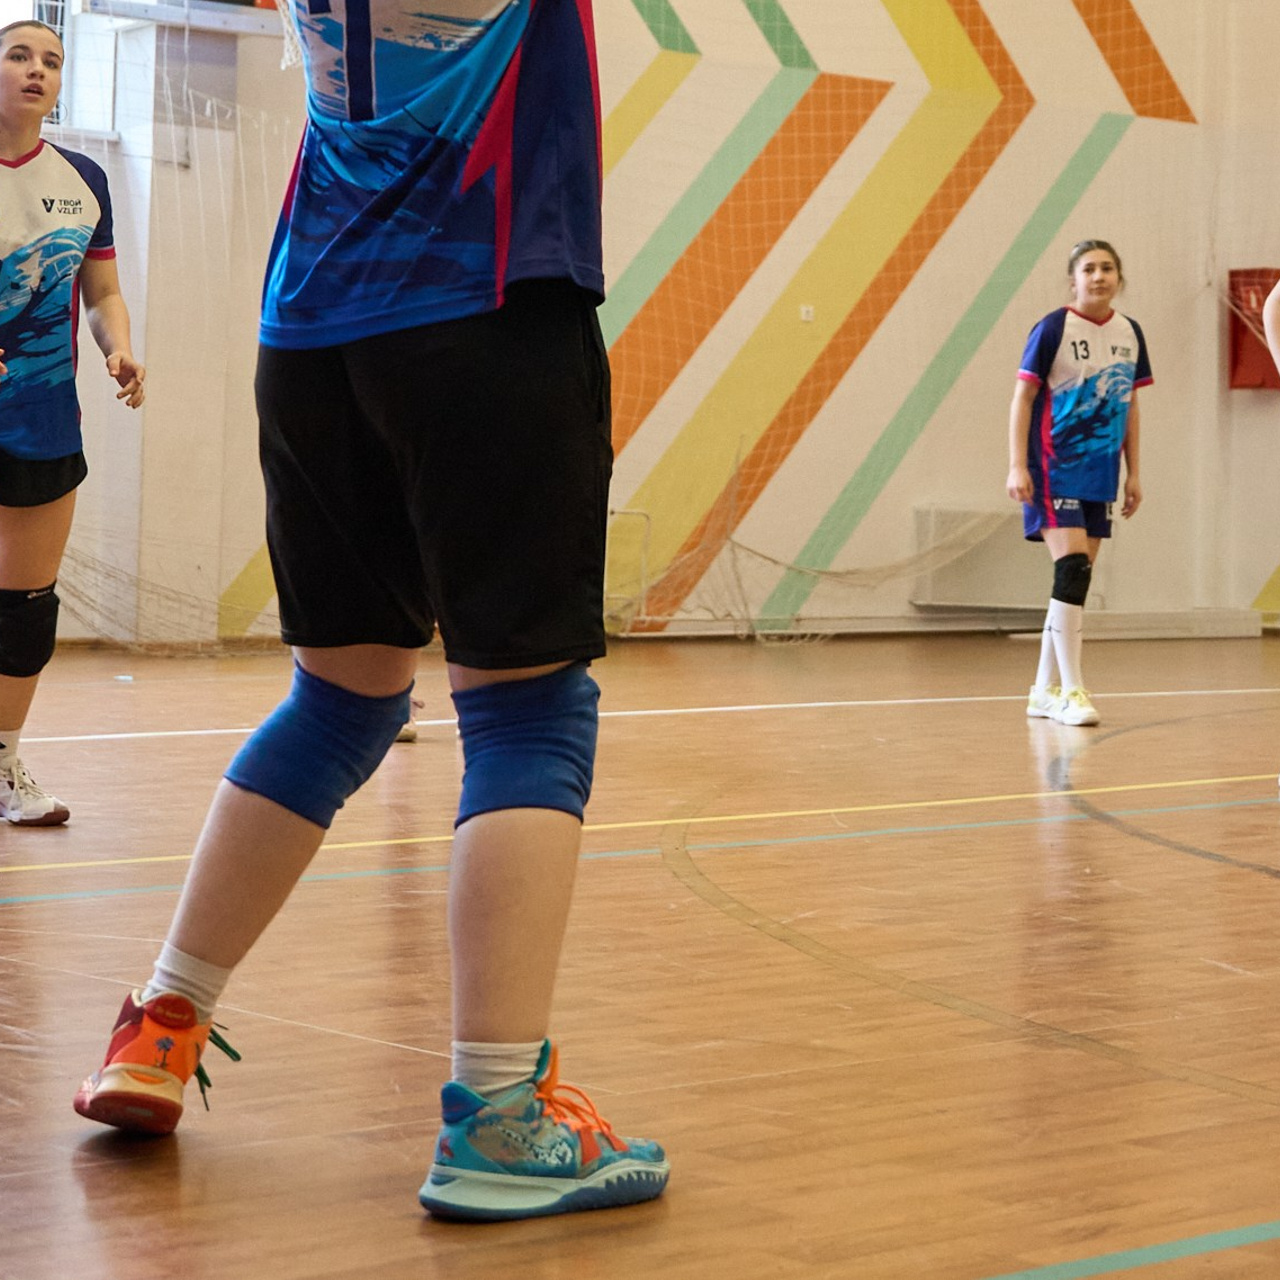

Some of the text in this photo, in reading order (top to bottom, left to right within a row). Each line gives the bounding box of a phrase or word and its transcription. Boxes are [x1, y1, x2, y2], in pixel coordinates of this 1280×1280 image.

[58, 198, 82, 207] ТВОЙ
[57, 207, 83, 215] VZLET
[1071, 339, 1090, 360] 13
